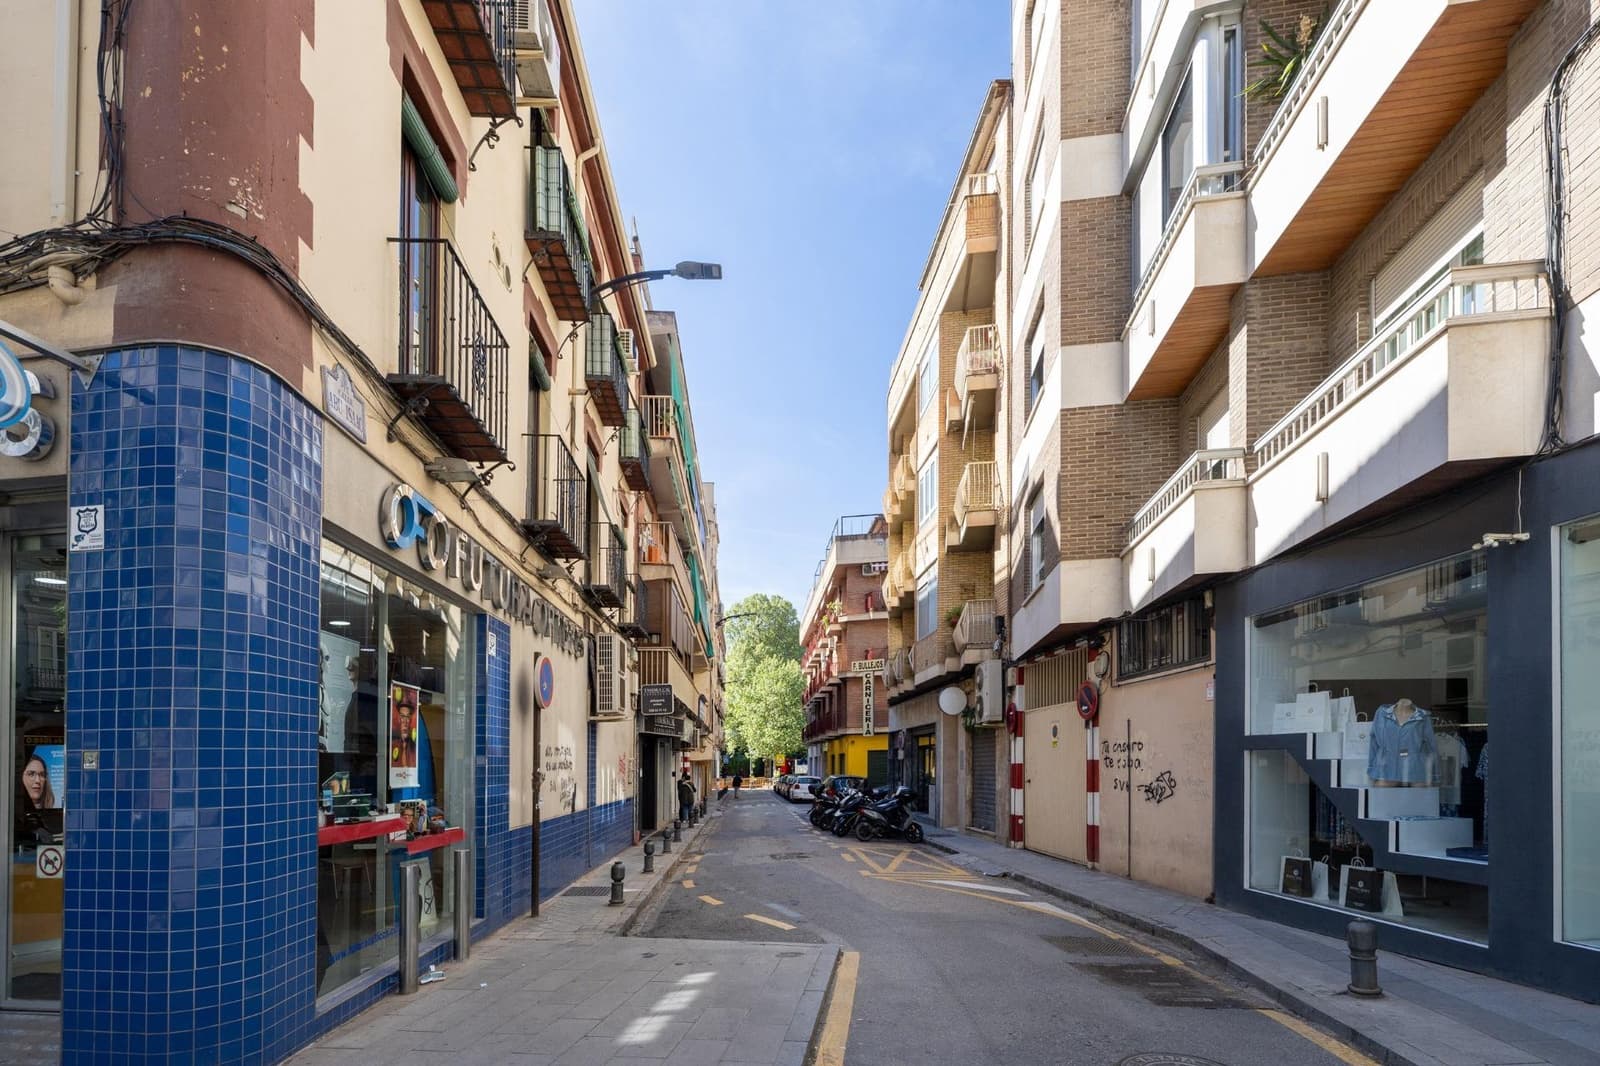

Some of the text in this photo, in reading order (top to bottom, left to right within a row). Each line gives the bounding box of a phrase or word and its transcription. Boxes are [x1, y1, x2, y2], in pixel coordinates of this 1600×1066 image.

[447, 527, 532, 626] FUTURA
[864, 673, 872, 735] CARNICERIA
[1104, 756, 1114, 768] te
